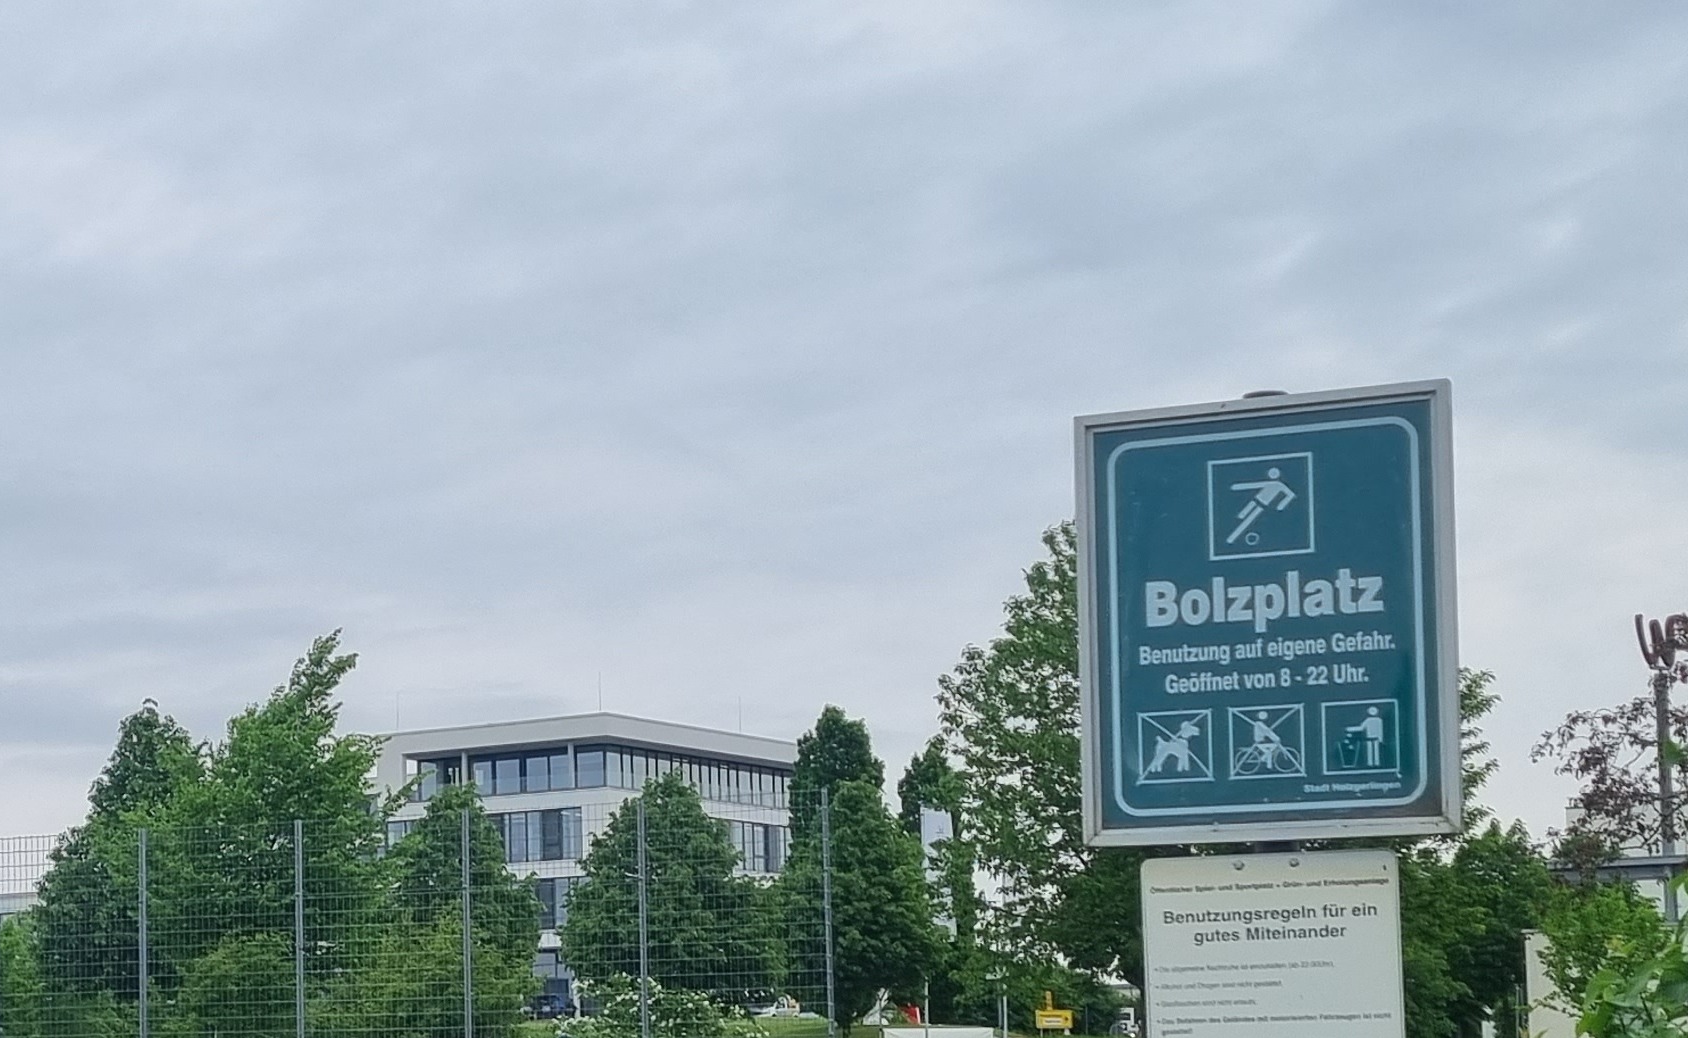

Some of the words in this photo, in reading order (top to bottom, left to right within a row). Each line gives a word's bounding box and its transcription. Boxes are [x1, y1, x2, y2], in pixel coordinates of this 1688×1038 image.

[1145, 567, 1385, 633] Bolzplatz
[1138, 643, 1231, 666] Benutzung
[1234, 638, 1263, 659] auf
[1267, 636, 1327, 661] eigene
[1331, 630, 1396, 653] Gefahr.
[1165, 670, 1240, 694] Geöffnet
[1243, 672, 1276, 689] von
[1279, 668, 1291, 687] 8
[1306, 665, 1329, 686] 22
[1332, 663, 1370, 684] Uhr.
[1162, 904, 1317, 925] Benutzungsregeln
[1322, 903, 1347, 918] für
[1351, 902, 1378, 917] ein
[1193, 928, 1241, 946] gutes
[1246, 924, 1347, 941] Miteinander
